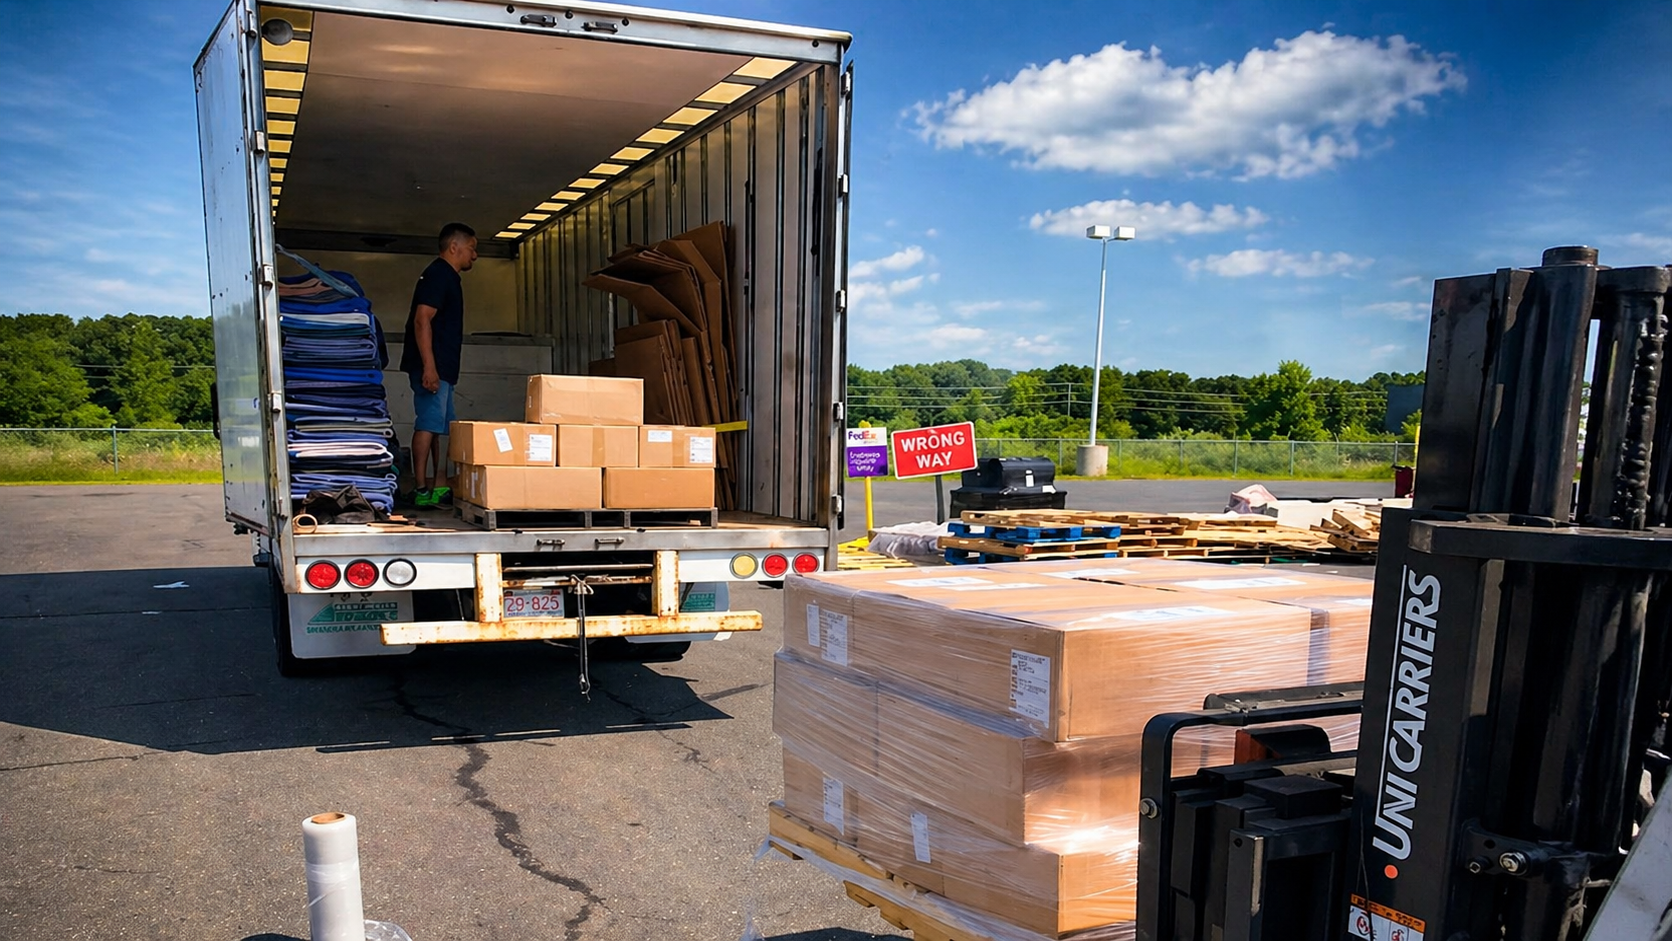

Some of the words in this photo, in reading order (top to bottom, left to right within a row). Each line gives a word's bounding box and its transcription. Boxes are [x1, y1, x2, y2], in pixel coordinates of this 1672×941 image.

[901, 431, 965, 453] WRONG
[916, 451, 952, 469] WAY
[1372, 569, 1441, 860] UNICARRIERS
